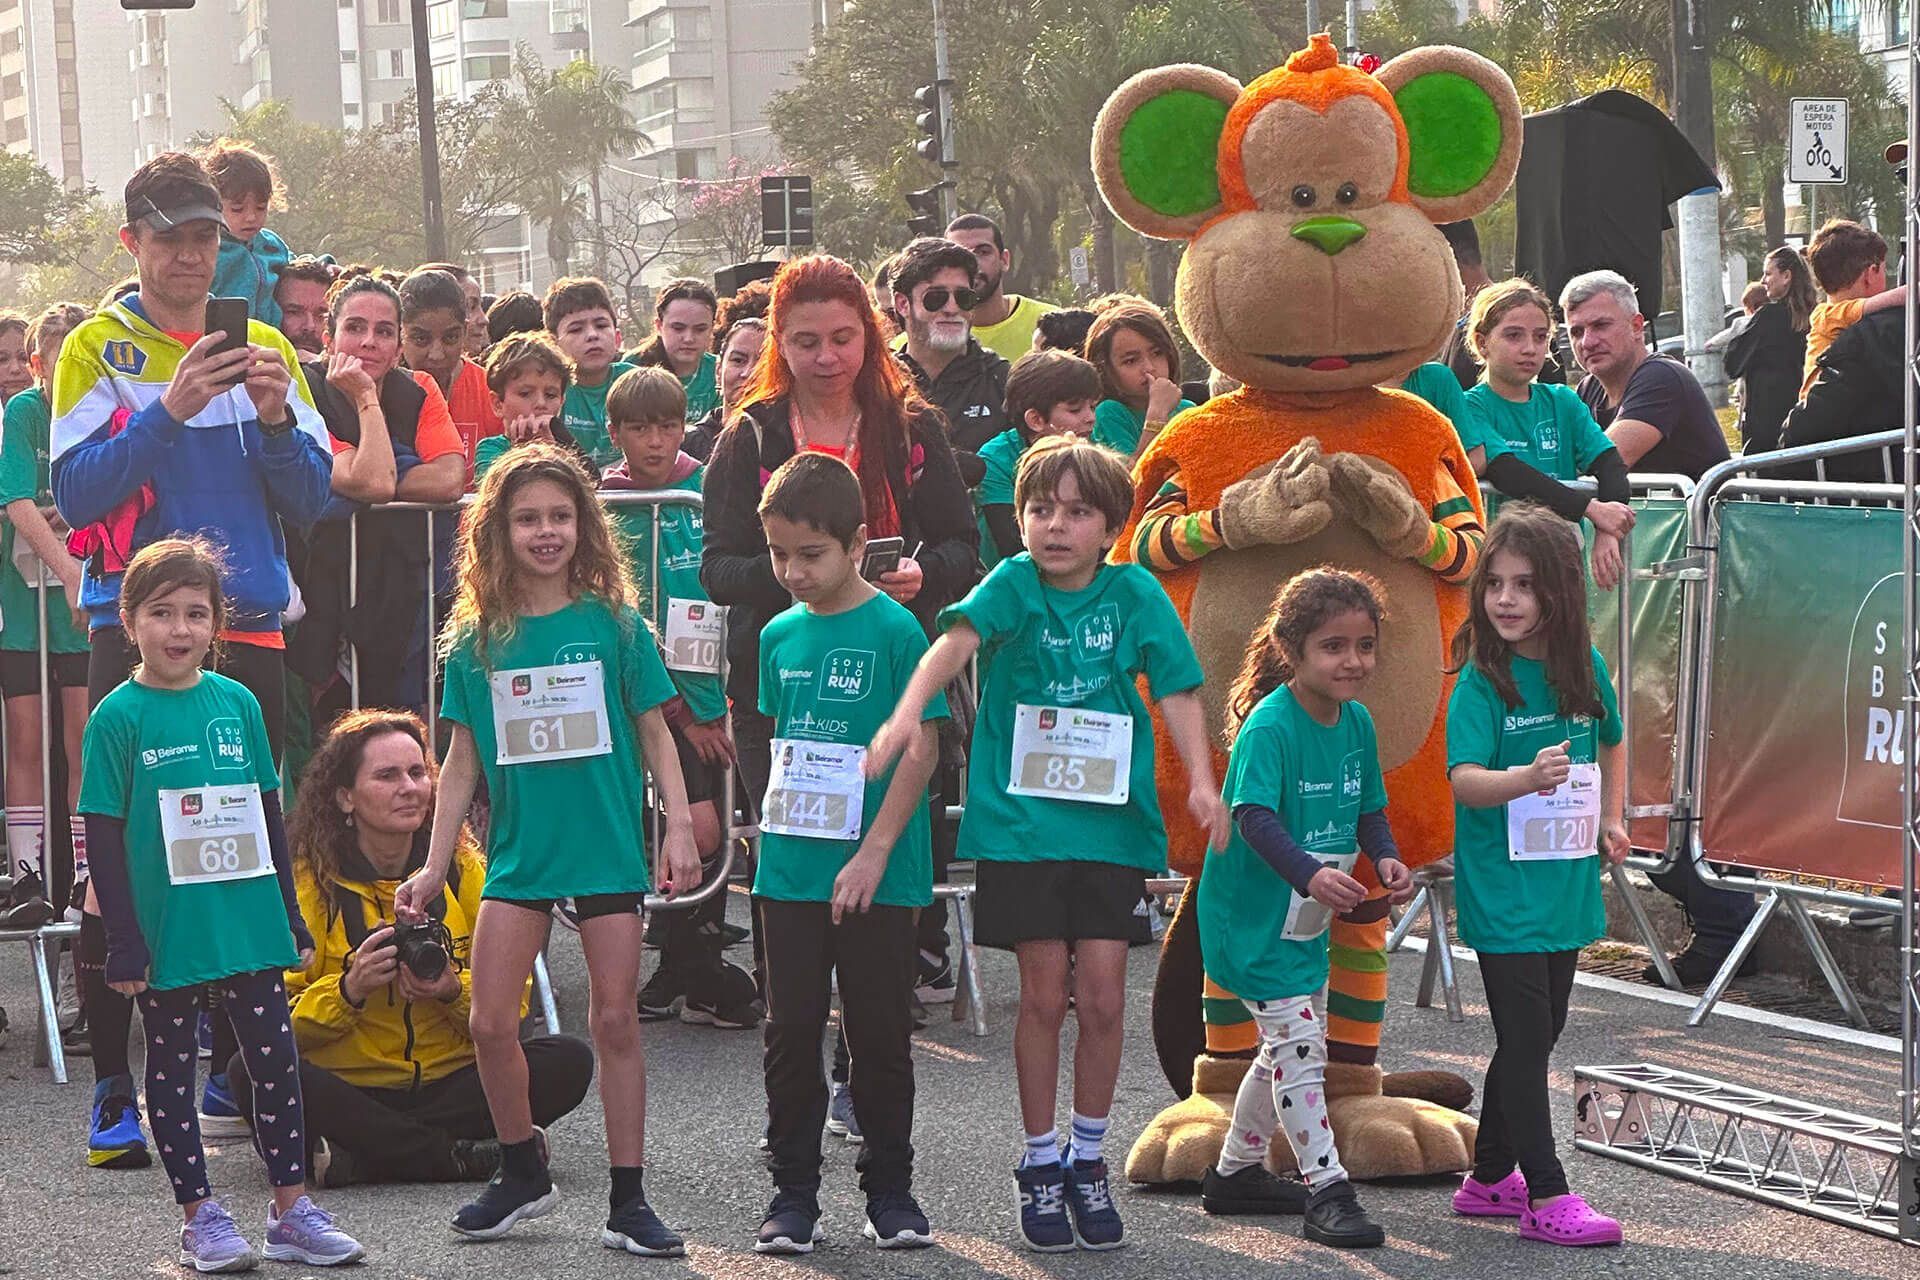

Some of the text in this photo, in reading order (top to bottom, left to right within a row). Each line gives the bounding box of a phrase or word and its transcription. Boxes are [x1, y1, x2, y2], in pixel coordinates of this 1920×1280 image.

[1826, 104, 1837, 112] DE
[1804, 113, 1834, 121] ESPERA
[1806, 122, 1833, 130] MOTOS
[1085, 631, 1113, 649] RUN
[564, 652, 596, 662] SOU
[832, 657, 864, 669] SOU
[831, 666, 863, 678] BIO
[827, 675, 862, 691] RUN
[815, 718, 849, 734] KIDS
[1517, 713, 1557, 728] Beiramar
[215, 726, 241, 736] SOU
[528, 716, 566, 753] 61
[217, 735, 243, 745] BIO
[156, 743, 199, 759] Beiramar
[219, 743, 244, 757] RUN
[1043, 755, 1086, 792] 85
[779, 790, 829, 827] 144
[1542, 818, 1588, 851] 120
[199, 837, 240, 874] 68
